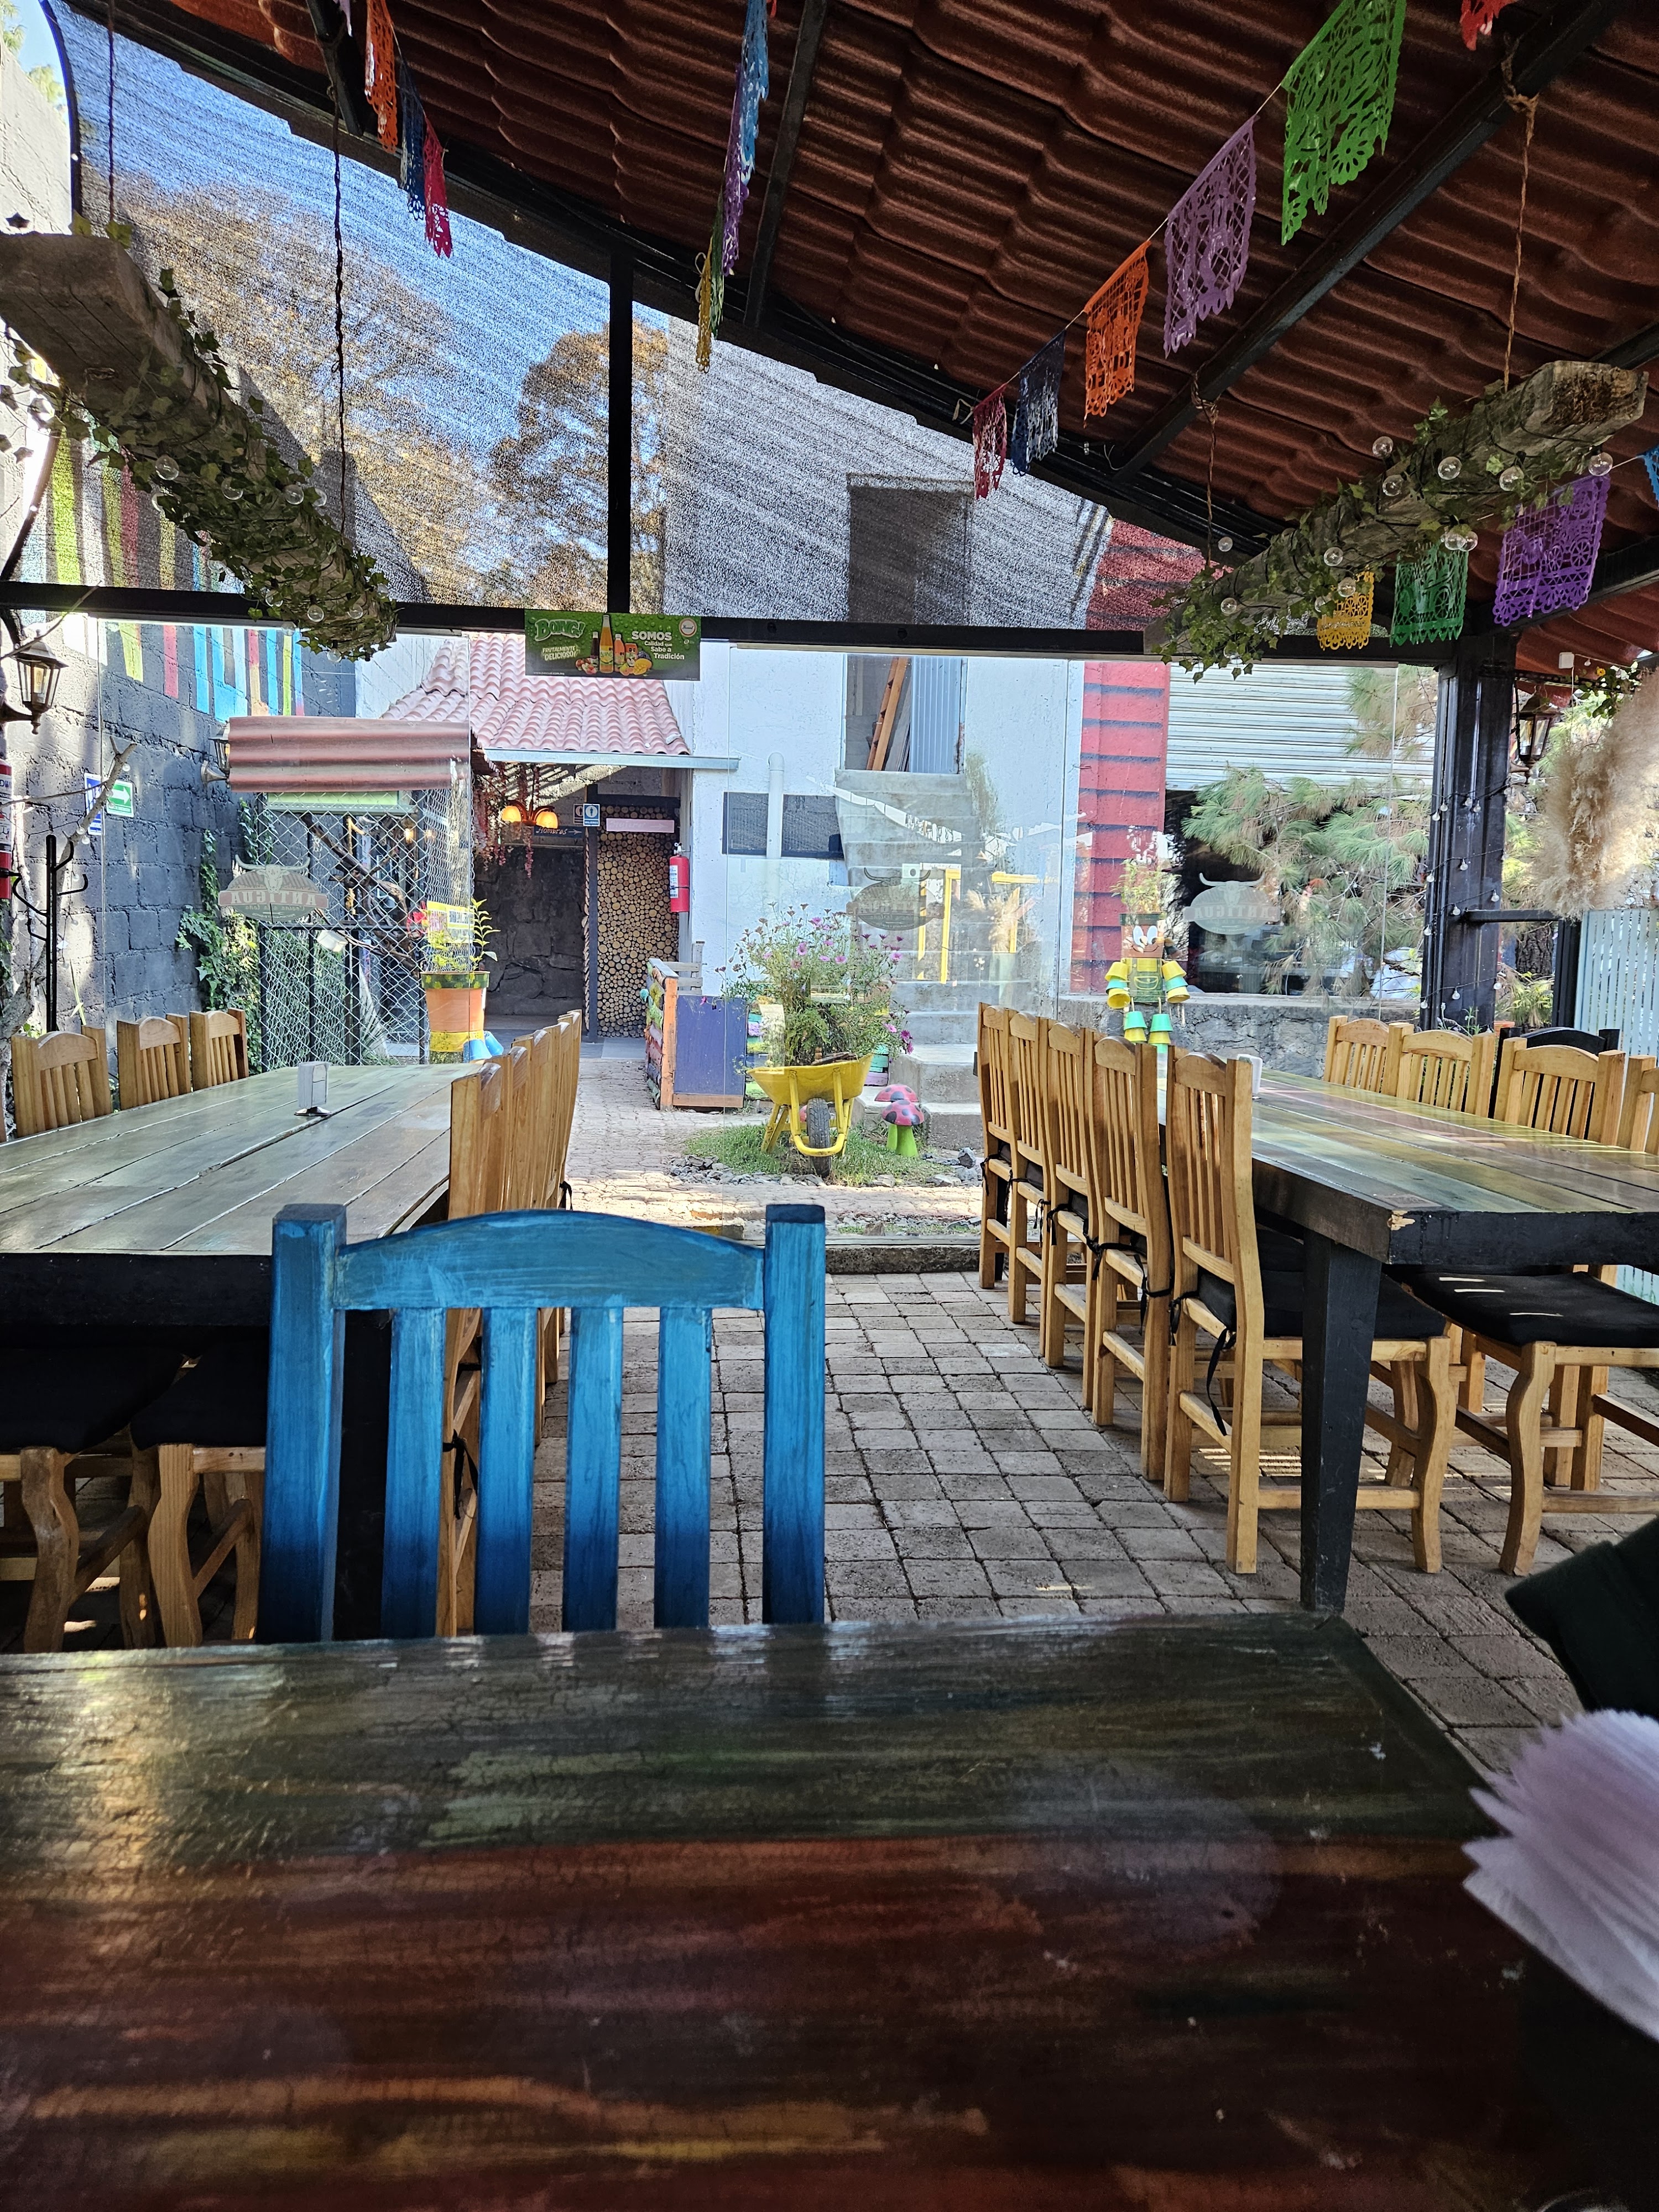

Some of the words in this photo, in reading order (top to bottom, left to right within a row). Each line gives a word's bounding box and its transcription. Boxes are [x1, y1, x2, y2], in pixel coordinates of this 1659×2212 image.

[535, 619, 586, 641] BOING!
[632, 631, 672, 641] SOMOS
[545, 651, 576, 661] DELICIOSO!
[535, 827, 568, 835] Hombres
